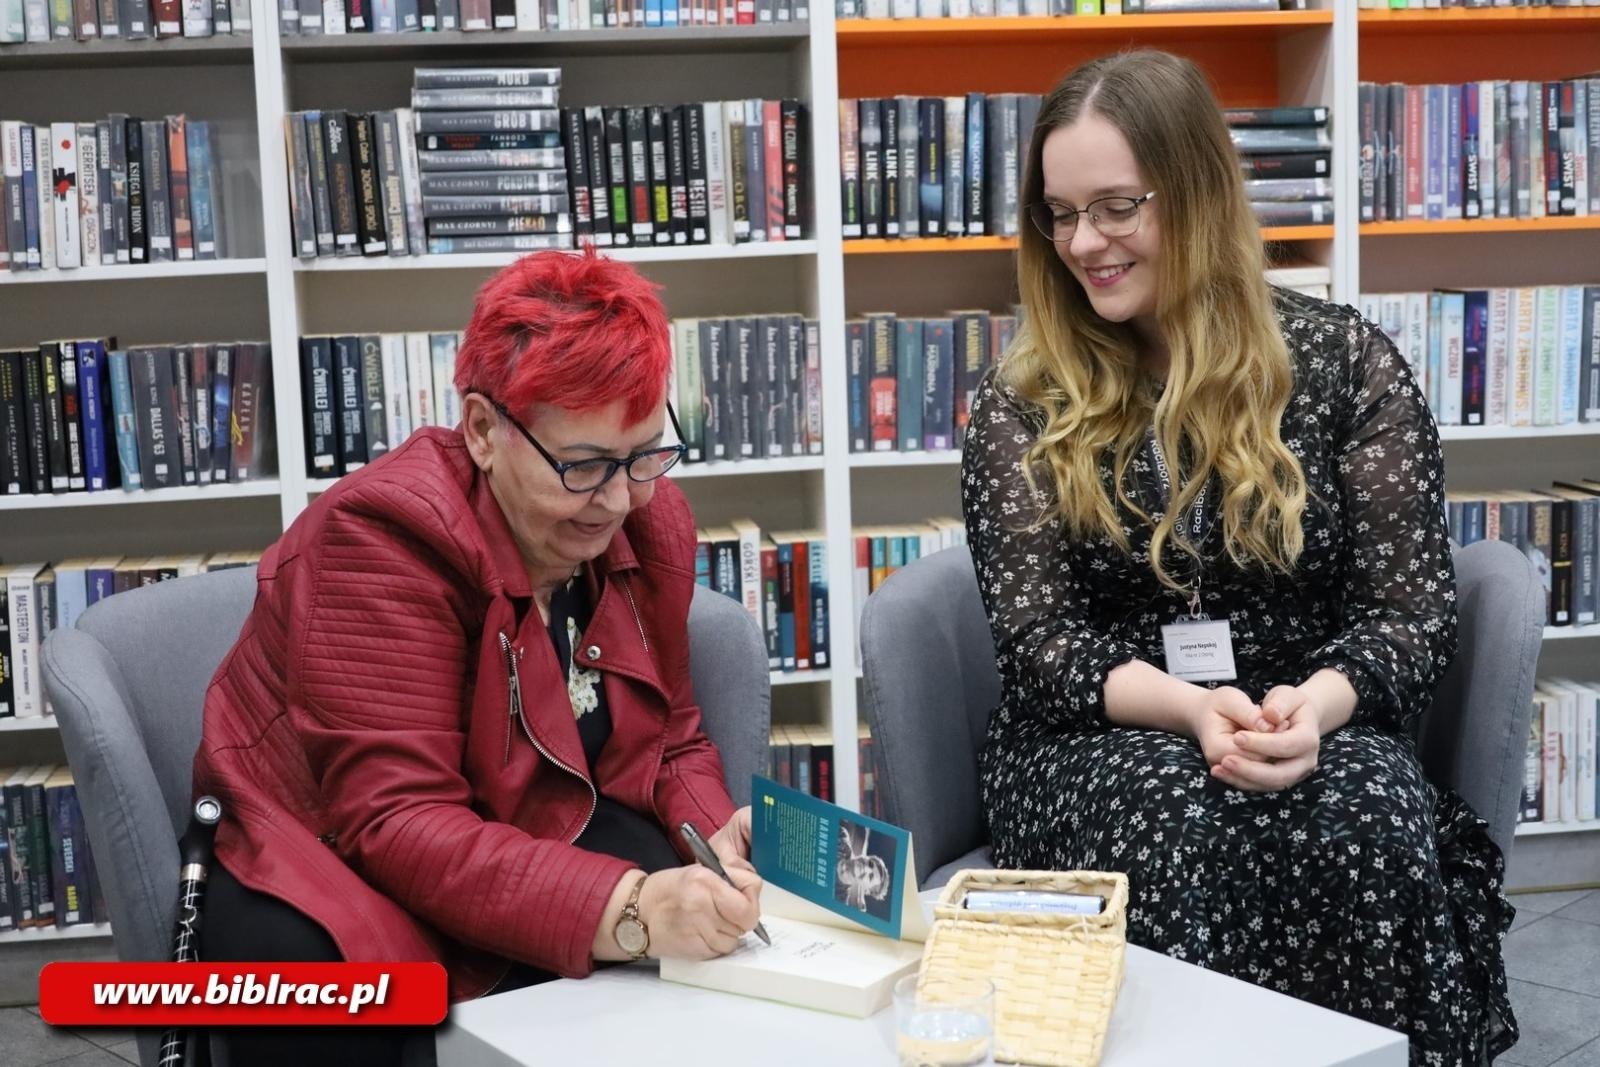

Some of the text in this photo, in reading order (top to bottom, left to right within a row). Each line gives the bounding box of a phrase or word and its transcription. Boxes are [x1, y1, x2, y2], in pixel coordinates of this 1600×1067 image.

[494, 110, 527, 129] GRÓB
[1590, 86, 1600, 147] PODEJRZANY
[358, 121, 369, 163] Harlan Coben
[673, 140, 681, 175] CZORNYJ
[785, 131, 797, 159] CZUBAJ
[951, 148, 961, 177] LINK
[971, 131, 981, 188] NAJGORSZY
[42, 160, 51, 203] GERRITSEN
[82, 145, 96, 196] GERRITSEN
[689, 110, 706, 217] MAX CZORNYJ BESTIA
[844, 151, 856, 180] LINK
[866, 151, 878, 181] LINK
[886, 149, 898, 179] LINK
[905, 148, 915, 178] LINK
[128, 162, 142, 233] KSIĘGA IMION
[575, 186, 591, 223] FATUM
[593, 187, 608, 219] WINA
[671, 186, 687, 218] KREW
[711, 180, 724, 210] INNA
[971, 190, 981, 215] DOM
[457, 221, 496, 229] CZORNYJ
[1519, 288, 1532, 333] MARTA
[710, 326, 720, 382] Åke Edwardson
[767, 326, 778, 341] Åke
[789, 325, 799, 380] Åke Edwardson
[875, 319, 888, 373] MARININA
[966, 319, 979, 373] MARININA
[45, 356, 56, 394] ALEX KAVA
[364, 342, 380, 401] ĆWIRLEJ
[740, 327, 750, 382] Åke Edwardson
[767, 342, 776, 382] Edwardson
[926, 344, 936, 393] MARININA
[1448, 337, 1459, 378] WCZORAJ
[313, 367, 328, 408] ĆWIRLEJ
[342, 367, 357, 408] ĆWIRLEJ
[7, 405, 19, 477] ŚMIERĆ FRAJEROM
[33, 403, 44, 475] ŚMIERĆ FRAJEROM
[150, 407, 164, 440] DALLAS
[743, 542, 756, 584] GÓRSKI
[16, 594, 30, 644] MASTERTON
[63, 838, 74, 873] SEVERSKI
[818, 817, 829, 856] HANNA
